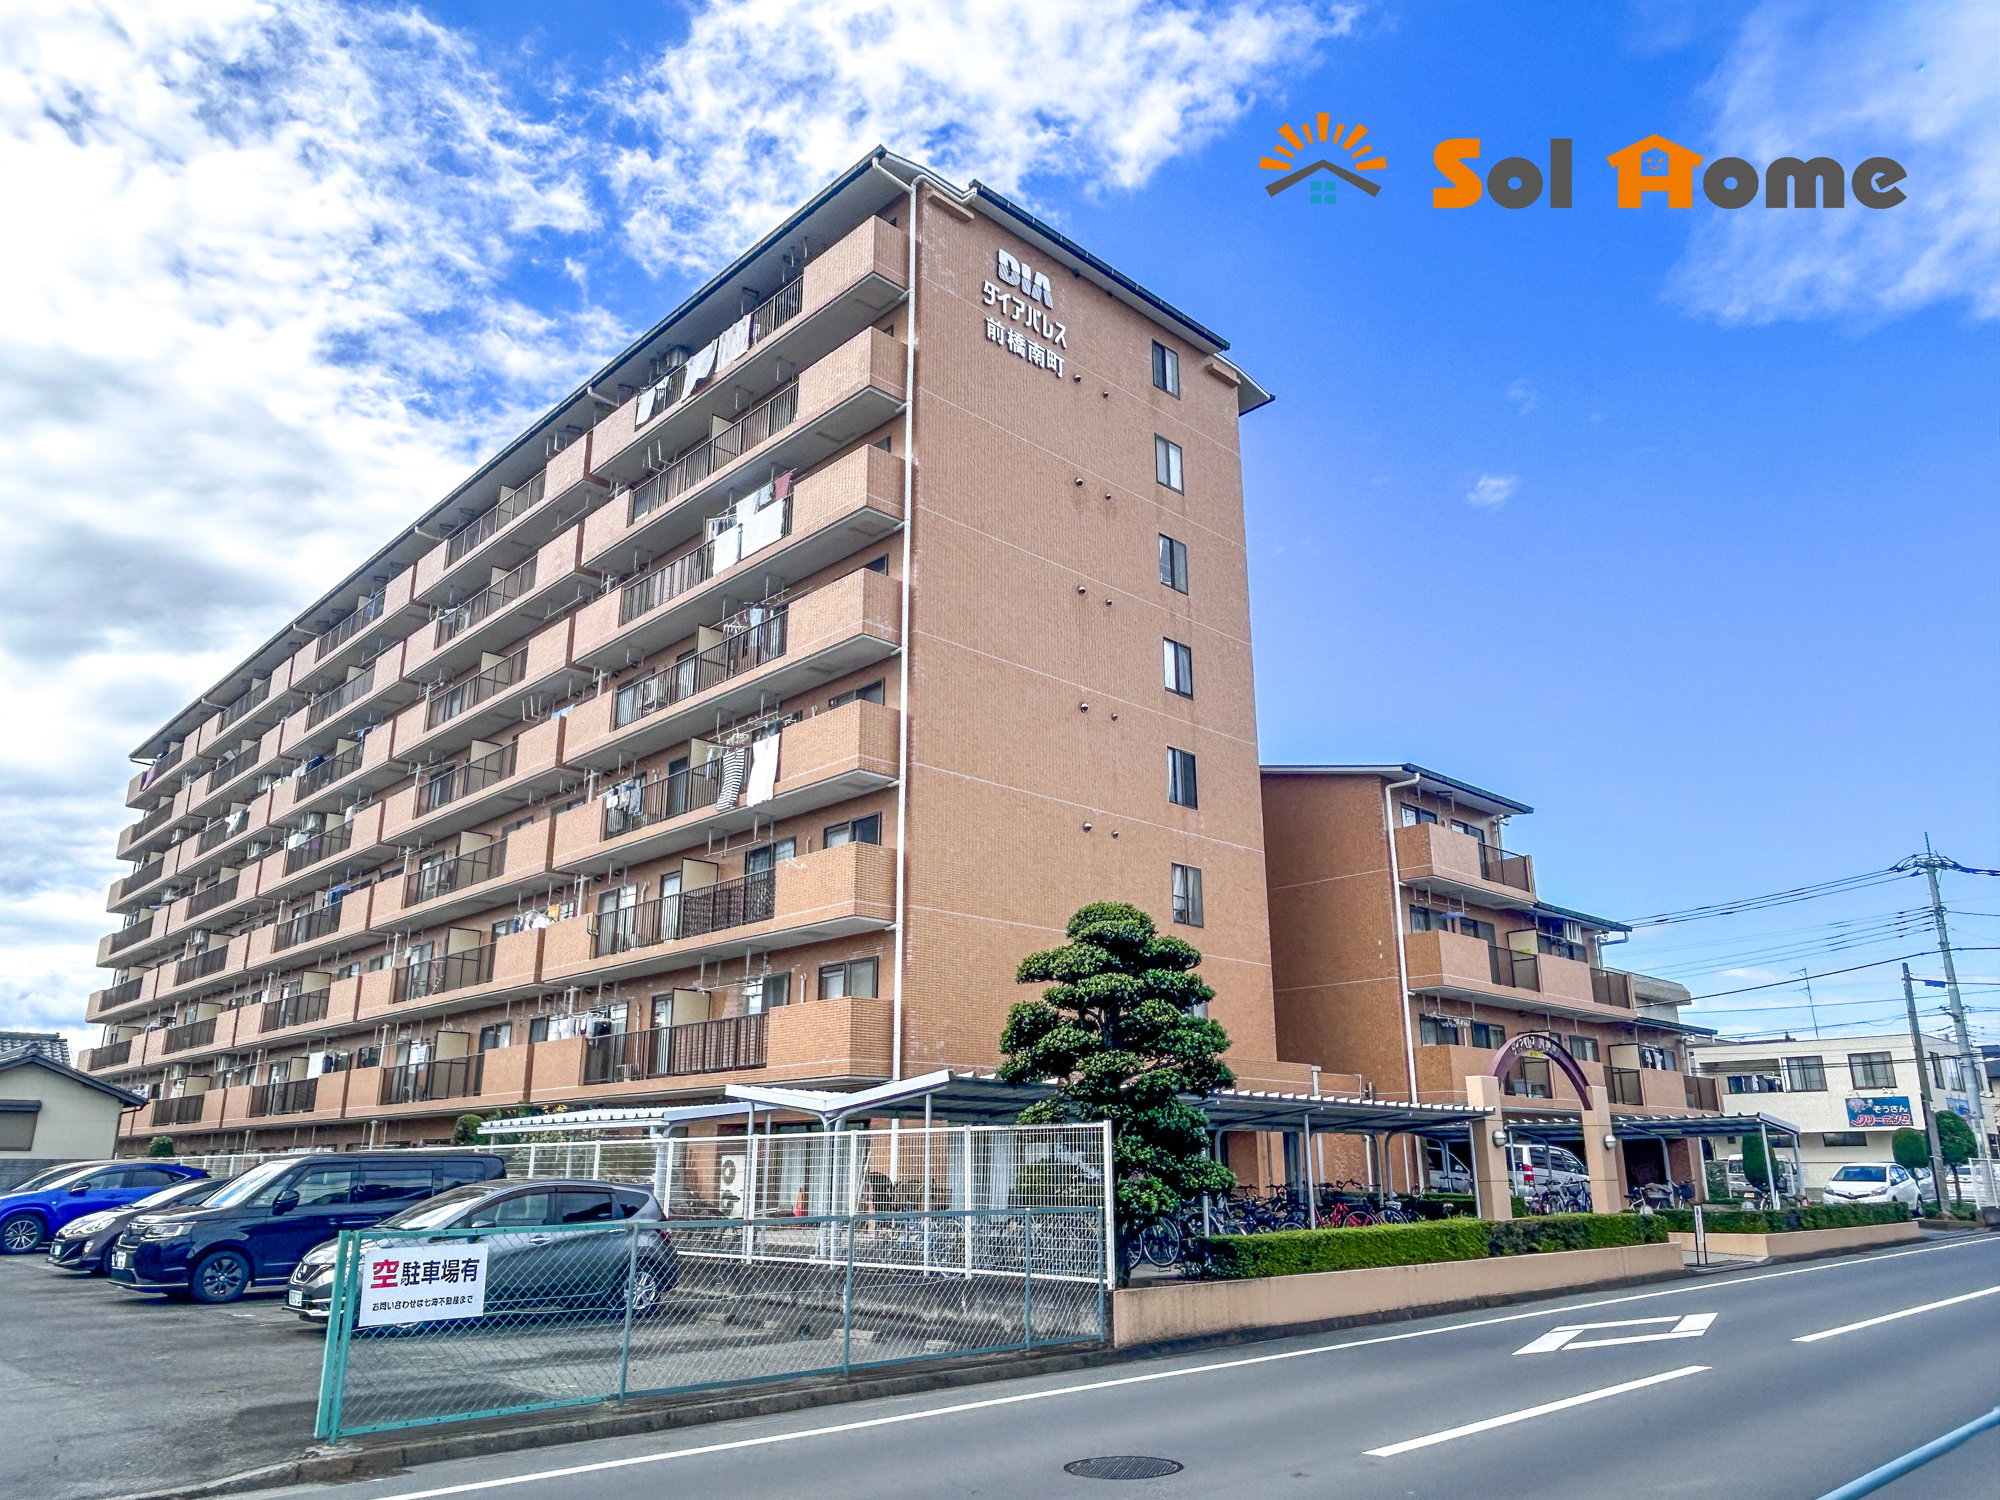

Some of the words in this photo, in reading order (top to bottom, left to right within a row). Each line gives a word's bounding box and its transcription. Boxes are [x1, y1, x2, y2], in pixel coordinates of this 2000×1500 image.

[998, 248, 1054, 310] DIA
[983, 279, 1068, 350] ダイアパレス
[986, 316, 1065, 379] 前橋南町
